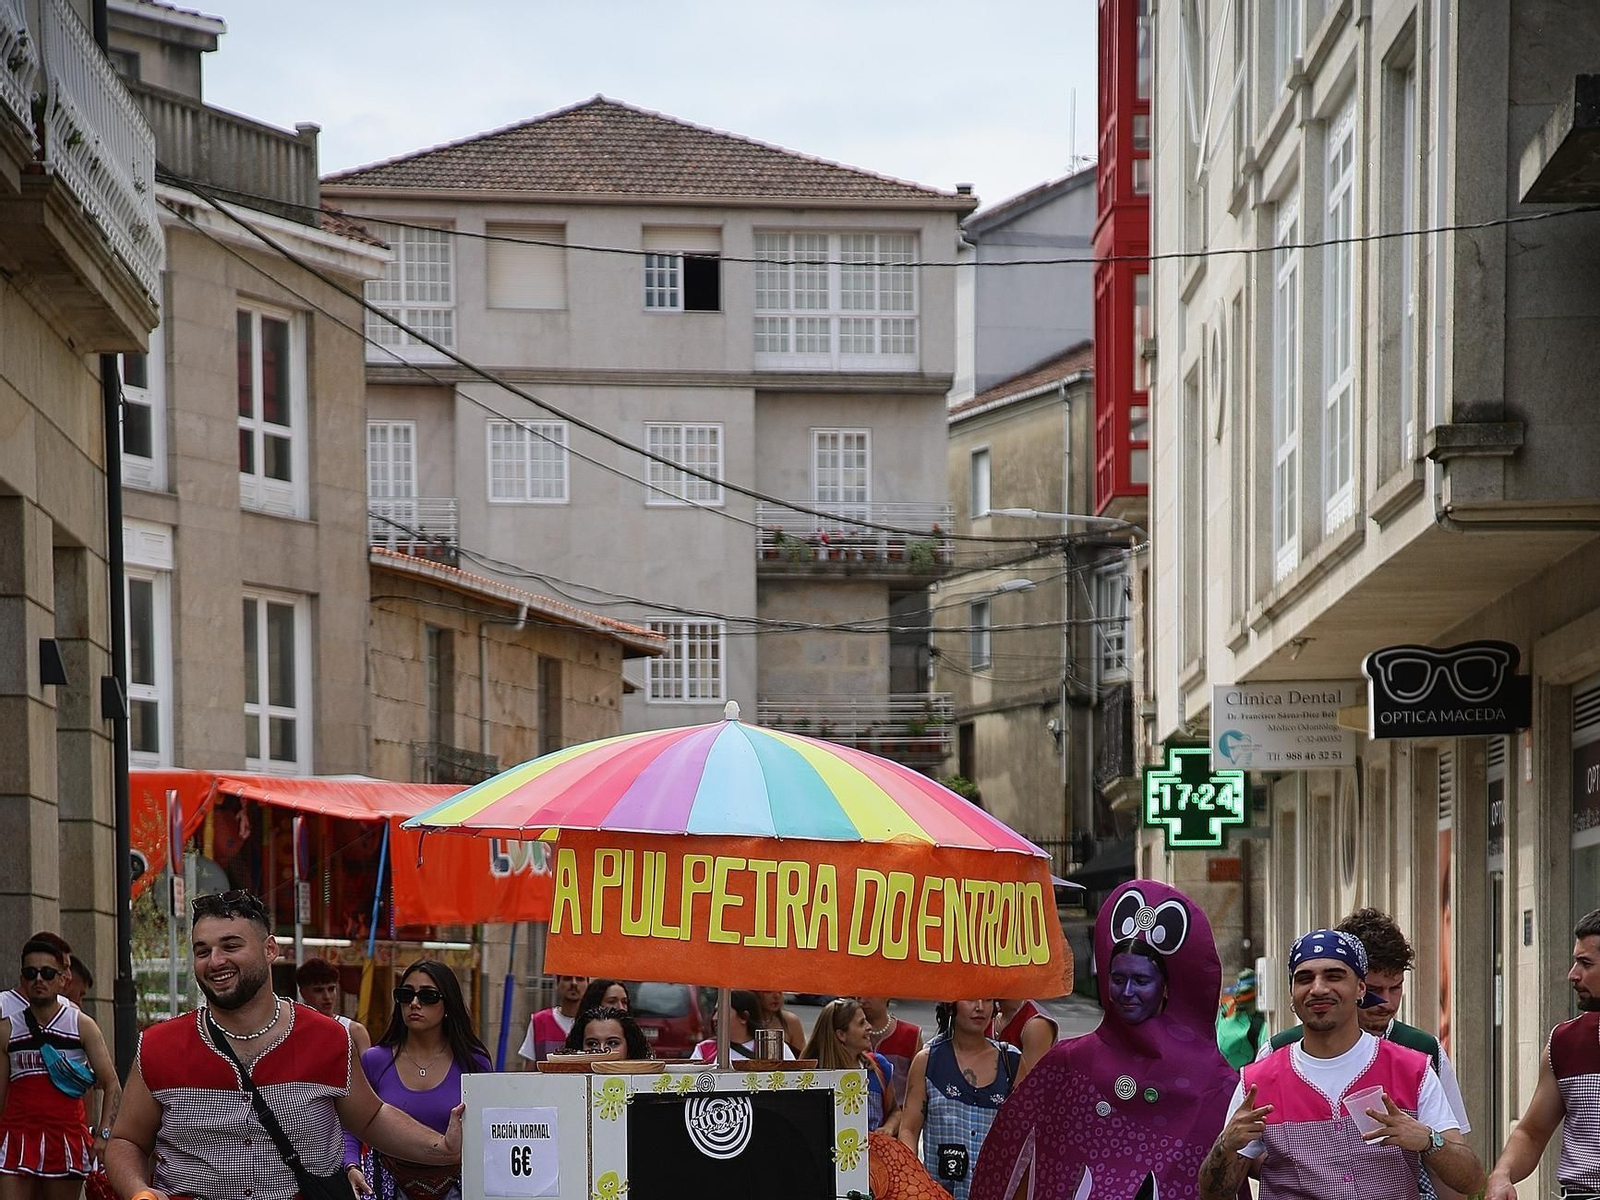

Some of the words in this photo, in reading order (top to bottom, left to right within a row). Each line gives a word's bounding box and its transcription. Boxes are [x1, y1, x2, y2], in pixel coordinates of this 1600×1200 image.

[1226, 690, 1282, 705] Clínica
[1289, 689, 1342, 704] Dental
[1380, 709, 1438, 724] OPTICA
[1440, 708, 1506, 723] MACEDA
[1286, 752, 1303, 761] 988
[1305, 752, 1317, 760] 46
[1331, 751, 1343, 759] 51
[1159, 784, 1234, 811] 17:24
[550, 848, 582, 935] A
[590, 848, 838, 952] PULPEIRA
[848, 868, 915, 960] DO
[490, 1120, 518, 1139] RACIÓN
[519, 1123, 550, 1139] NORMAL
[511, 1145, 533, 1177] 6€
